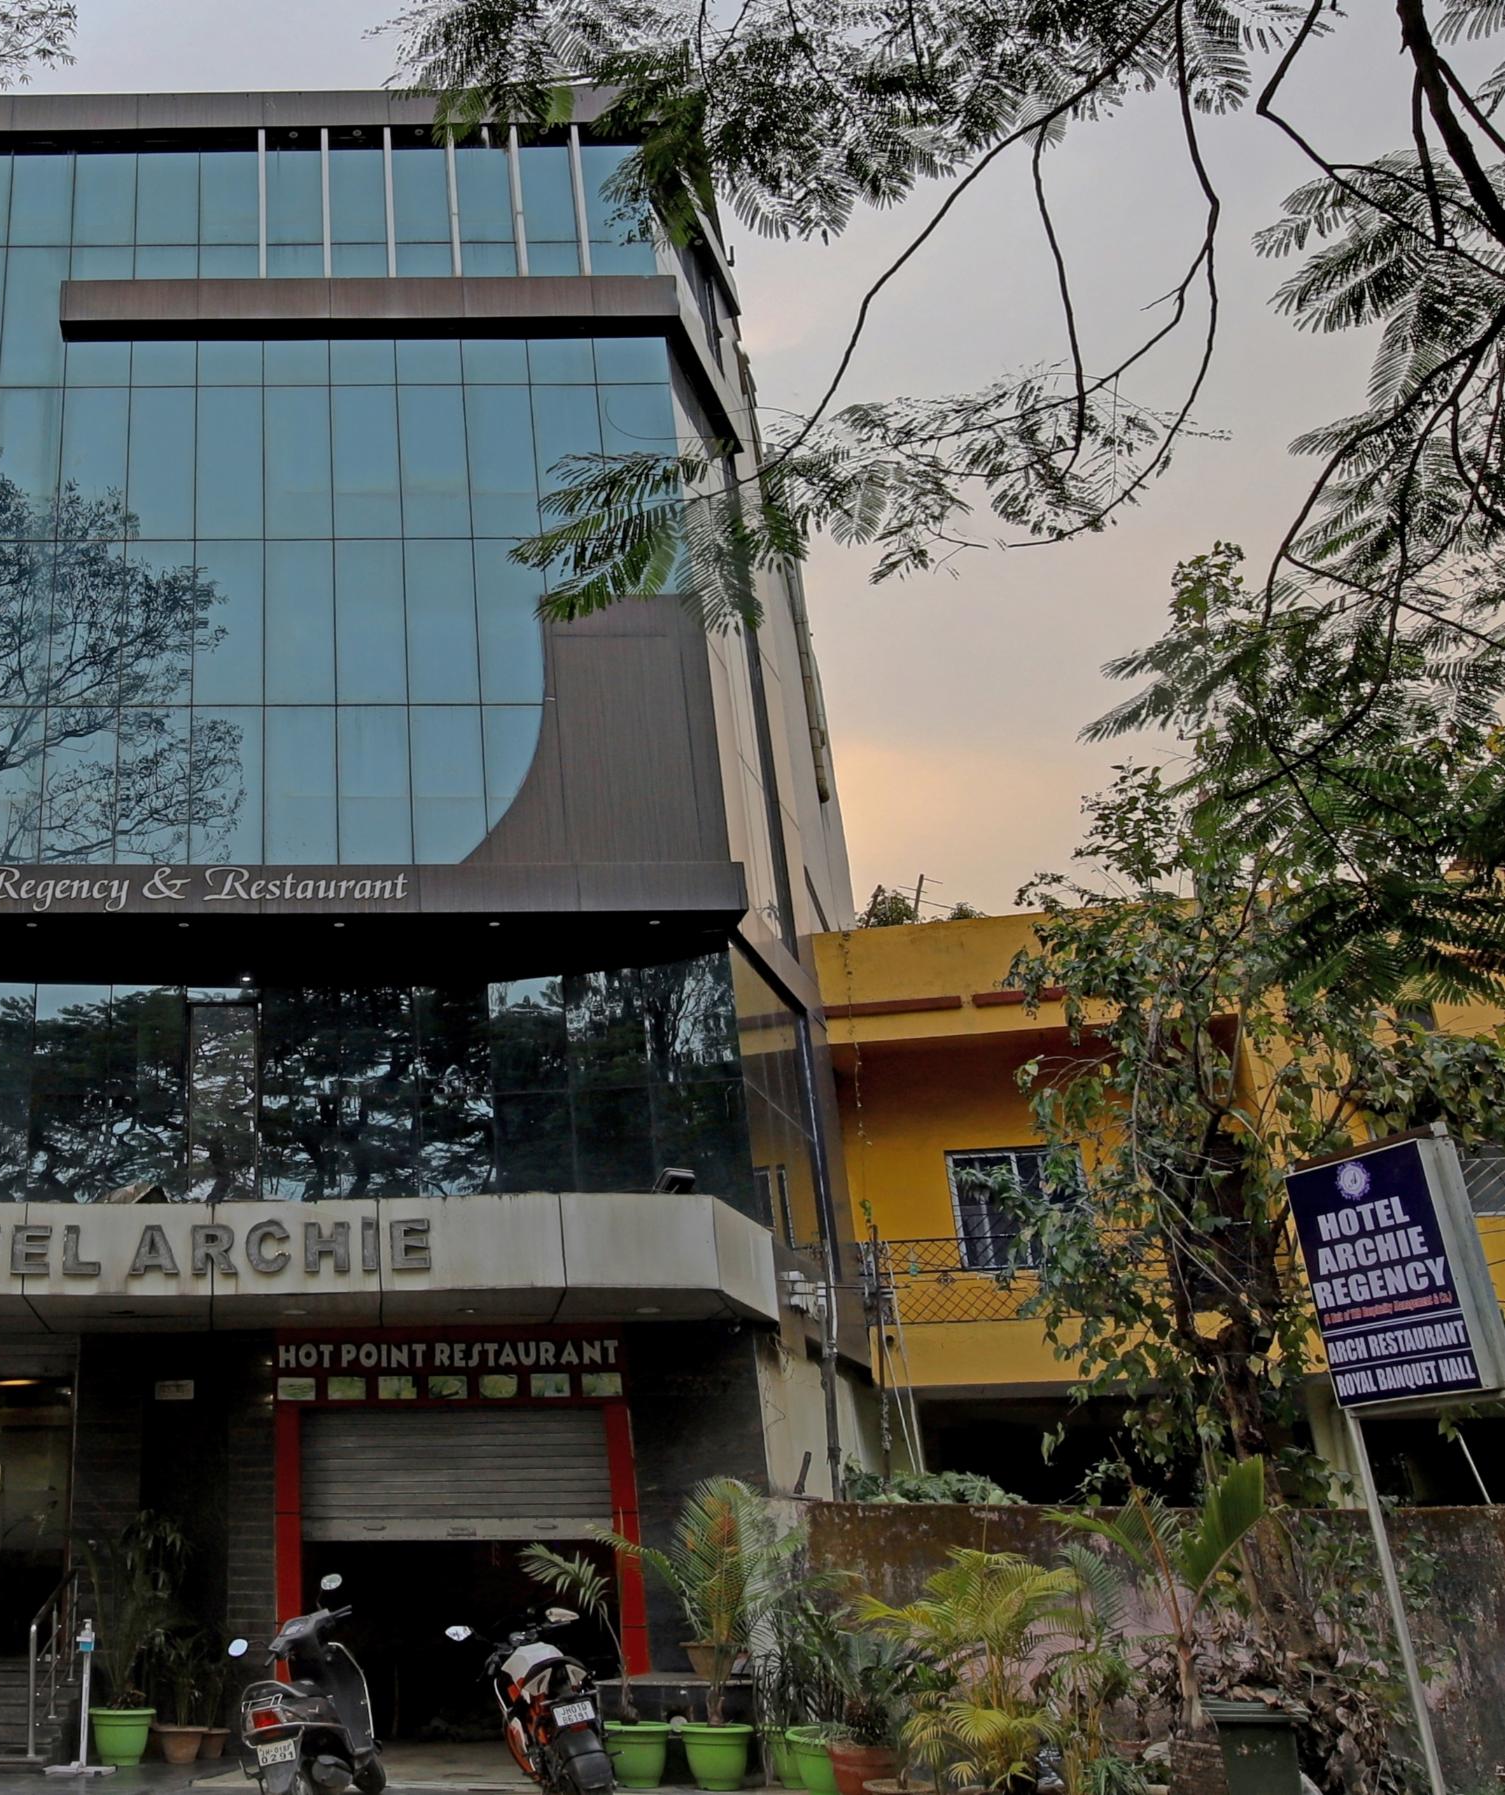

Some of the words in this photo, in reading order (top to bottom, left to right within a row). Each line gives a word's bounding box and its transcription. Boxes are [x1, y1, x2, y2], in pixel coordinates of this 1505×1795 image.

[142, 866, 192, 900] &
[202, 866, 409, 901] Restaurant
[1317, 1196, 1410, 1241] HOTEL
[128, 1216, 432, 1276] ARCHIE
[1317, 1225, 1429, 1276] ARCHIE
[1313, 1256, 1447, 1309] REGENCY
[278, 1343, 334, 1368] HOT
[341, 1343, 427, 1368] POINT
[434, 1340, 619, 1368] RESTAURANT
[1327, 1334, 1370, 1365] ARCH
[1370, 1320, 1466, 1359] RESTAURANT
[1335, 1370, 1377, 1397] ROYAL
[1377, 1360, 1437, 1391] BANQUET
[1439, 1356, 1476, 1382] HALL
[262, 1752, 293, 1763] 0291
